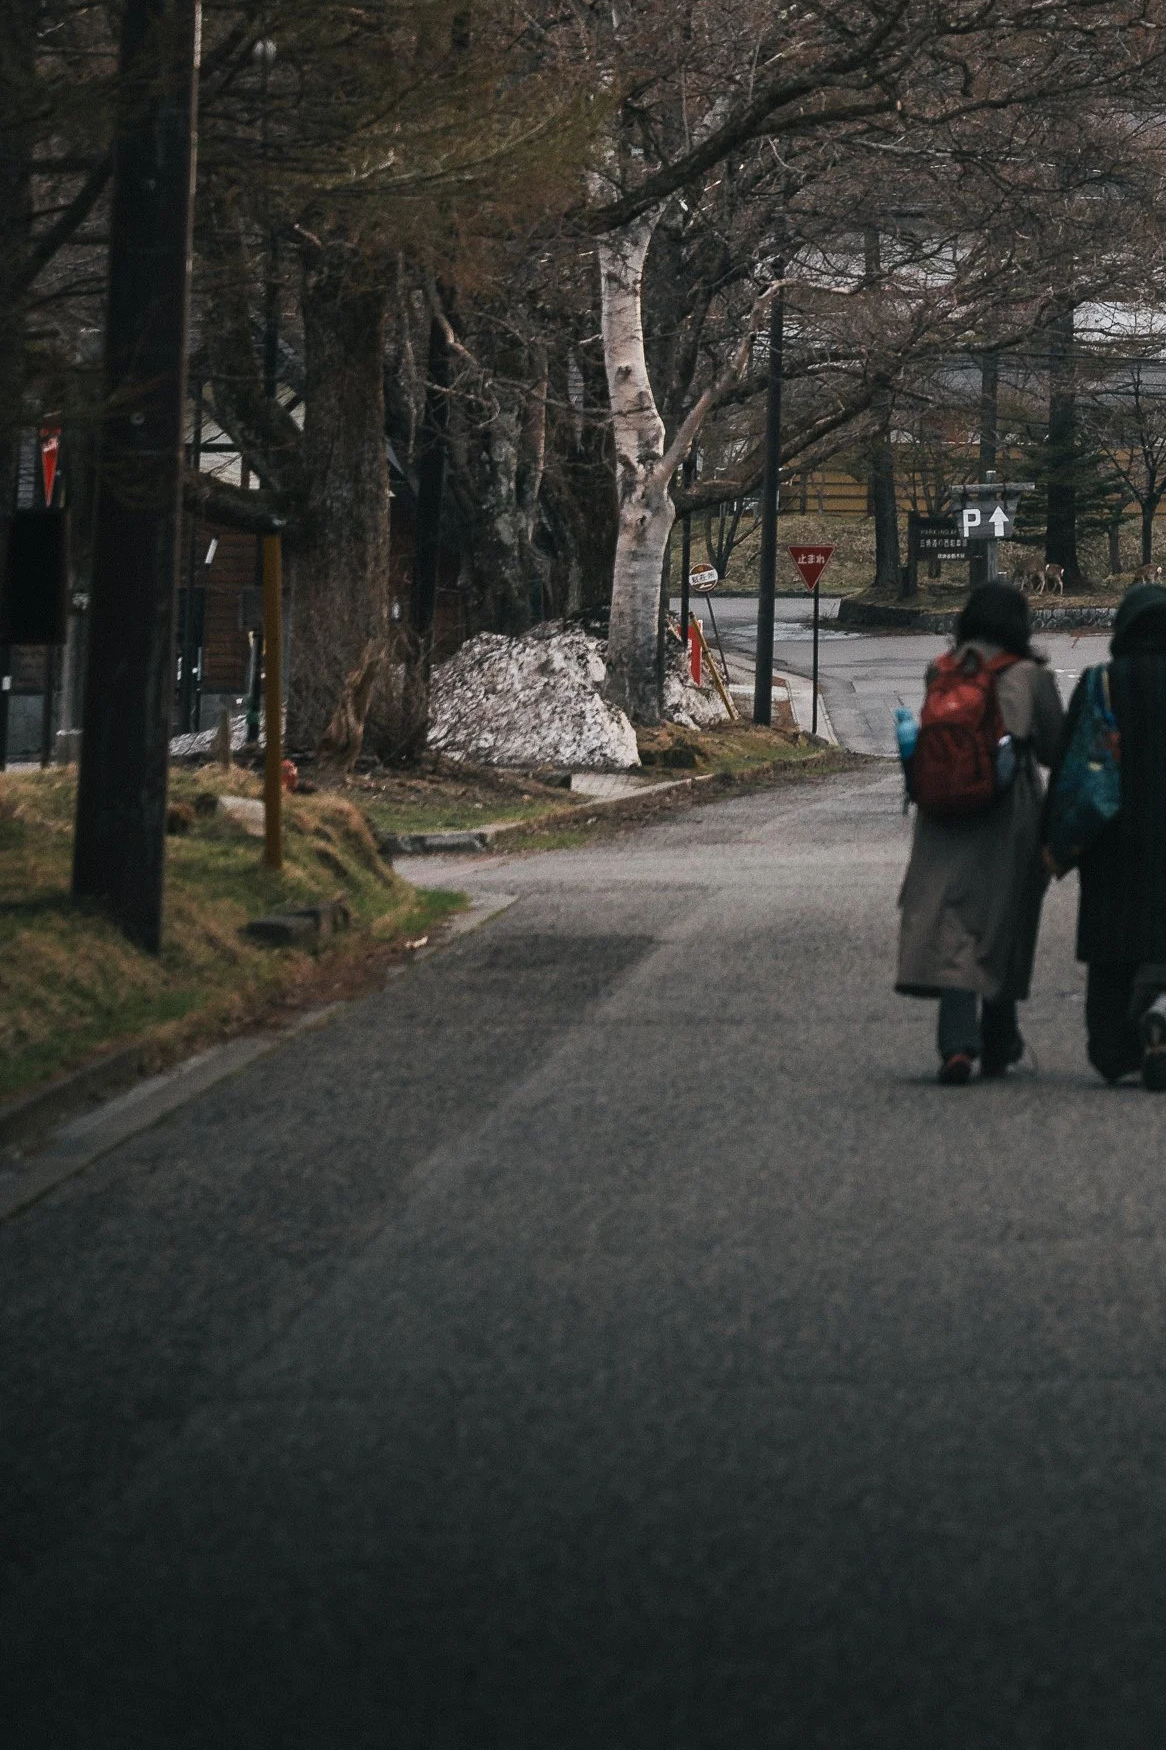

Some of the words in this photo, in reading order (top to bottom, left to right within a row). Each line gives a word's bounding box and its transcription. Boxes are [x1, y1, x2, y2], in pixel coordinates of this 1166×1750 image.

[963, 508, 981, 538] P
[798, 554, 825, 564] 止まれ
